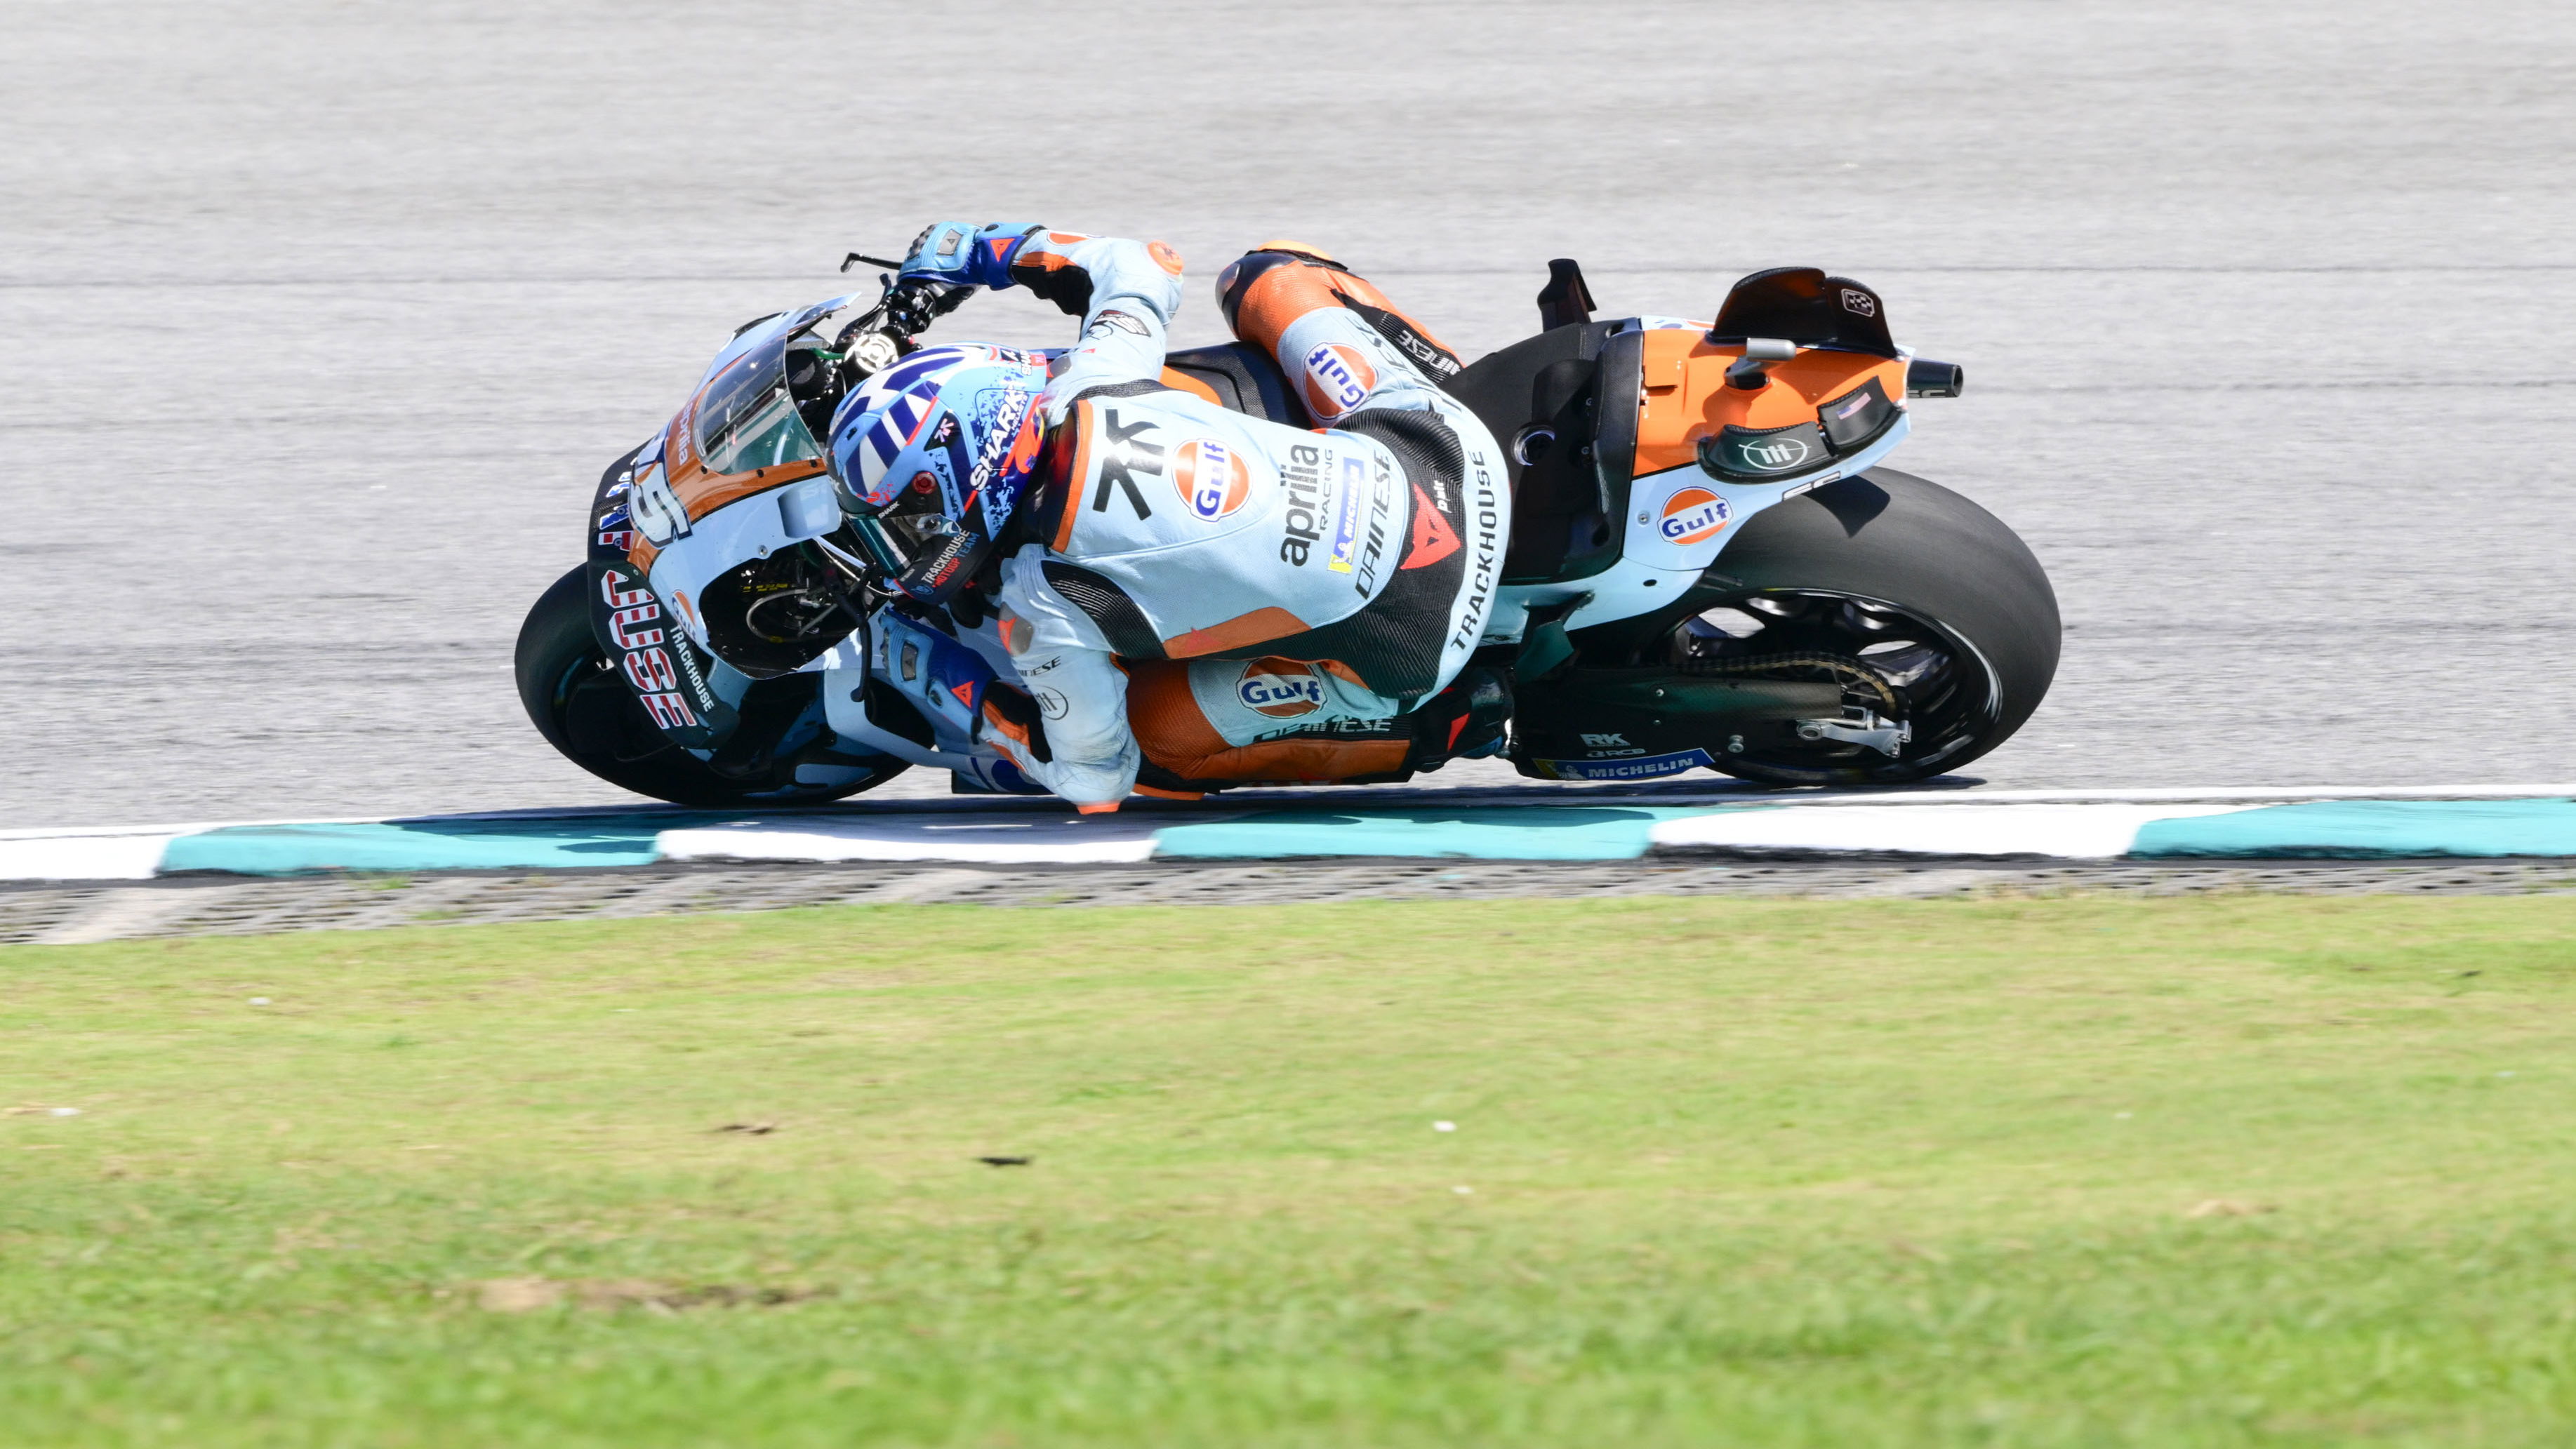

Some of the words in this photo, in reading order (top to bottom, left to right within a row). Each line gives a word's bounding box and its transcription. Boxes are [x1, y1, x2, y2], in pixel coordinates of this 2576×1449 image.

[1309, 348, 1365, 408] Gulf
[679, 402, 693, 466] aprilia
[970, 382, 1025, 490] SHARK
[877, 501, 900, 519] SHARK
[1195, 441, 1225, 516] Gulf
[1280, 444, 1320, 567] aprilia
[1319, 448, 1334, 531] RACING
[1343, 465, 1360, 538] MICHELIN
[955, 532, 981, 557] TEAM
[1355, 449, 1390, 601] DAINESE
[1450, 450, 1497, 650] TRACKHOUSE
[1661, 502, 1727, 538] Gulf
[922, 528, 970, 584] TRACKHOUSE
[670, 624, 715, 713] TRACKHOUSE
[1241, 680, 1320, 705] Gulf
[1579, 733, 1631, 747] RK
[1588, 757, 1694, 778] MICHELIN
